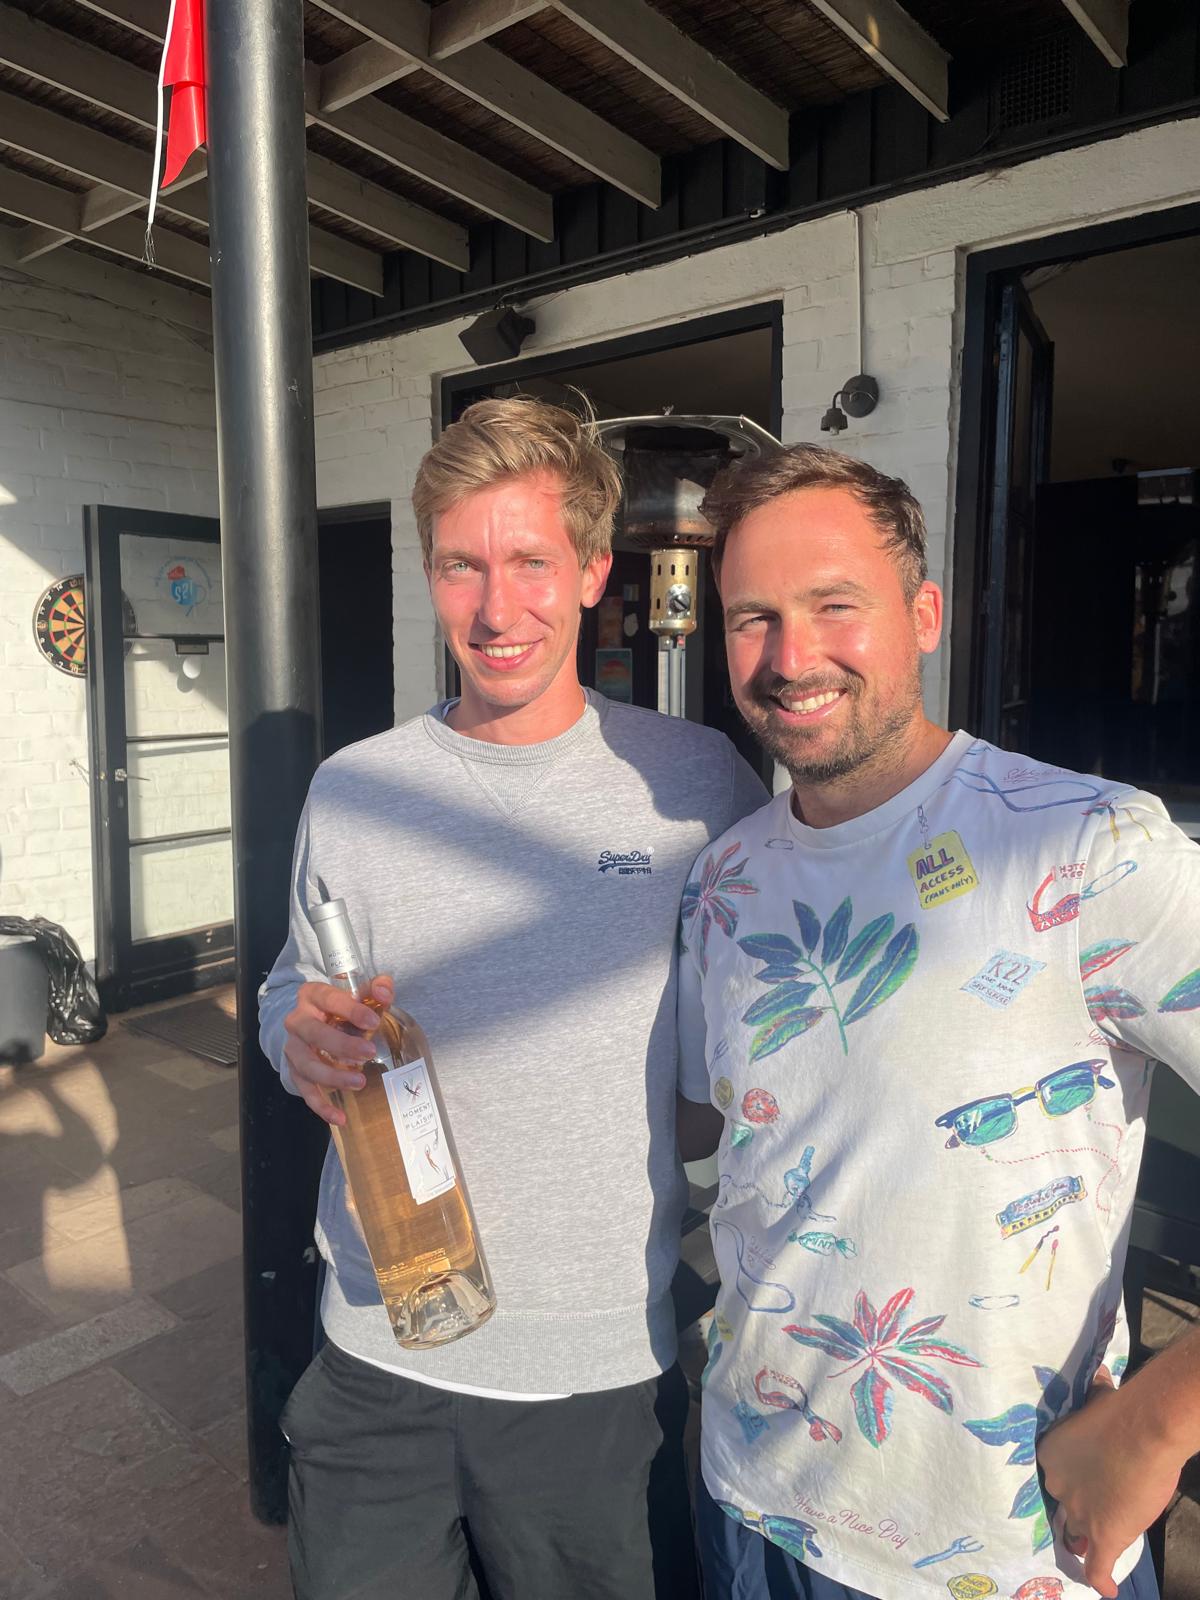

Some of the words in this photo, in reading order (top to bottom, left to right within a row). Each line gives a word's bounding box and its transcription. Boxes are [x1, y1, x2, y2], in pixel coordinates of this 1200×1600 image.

[916, 847, 955, 880] ALL
[920, 864, 965, 894] ACCESS
[988, 959, 1031, 986] K22
[402, 1102, 431, 1118] MOMENT
[826, 1514, 838, 1525] a
[839, 1509, 875, 1535] Nice
